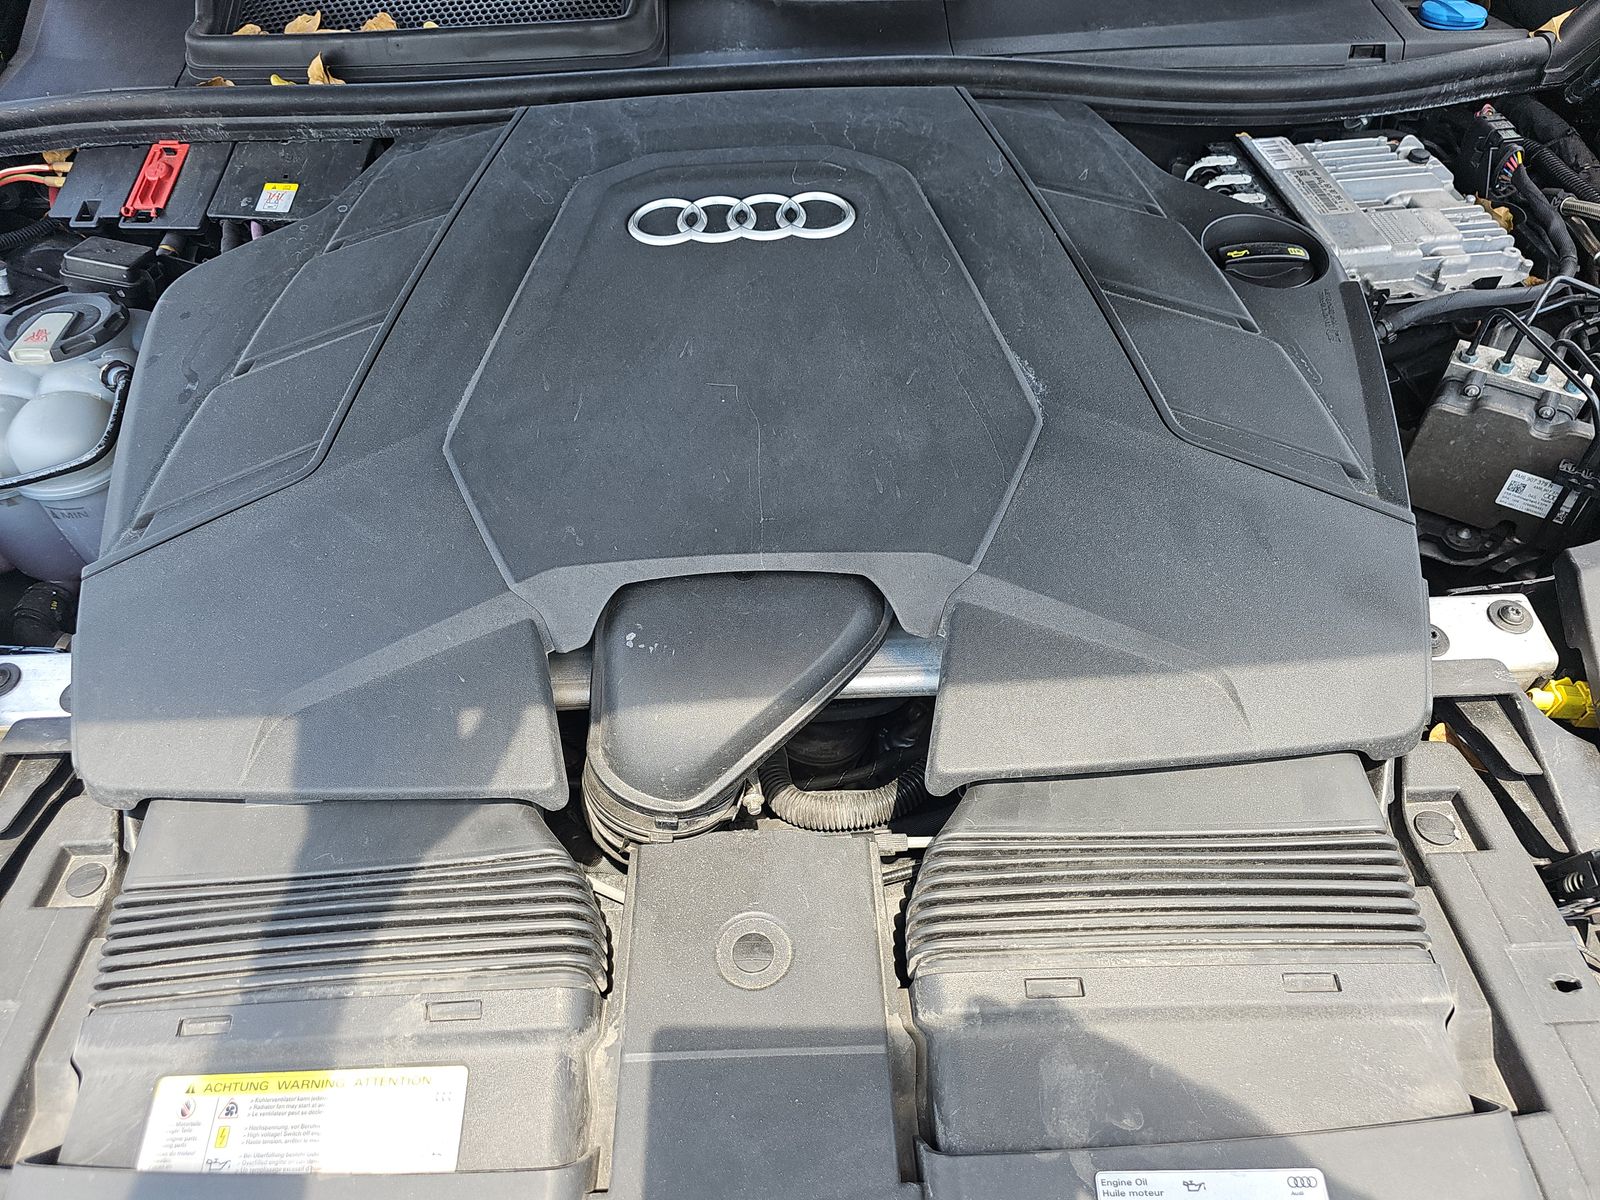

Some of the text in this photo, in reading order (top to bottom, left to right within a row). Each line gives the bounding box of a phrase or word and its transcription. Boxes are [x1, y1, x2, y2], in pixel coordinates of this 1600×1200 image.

[60, 510, 89, 519] MIN
[203, 1076, 432, 1093] ACHTUNG WARNING ATTENTION
[1101, 1178, 1148, 1188] Engine Oil
[1102, 1189, 1164, 1197] Huile moteur
